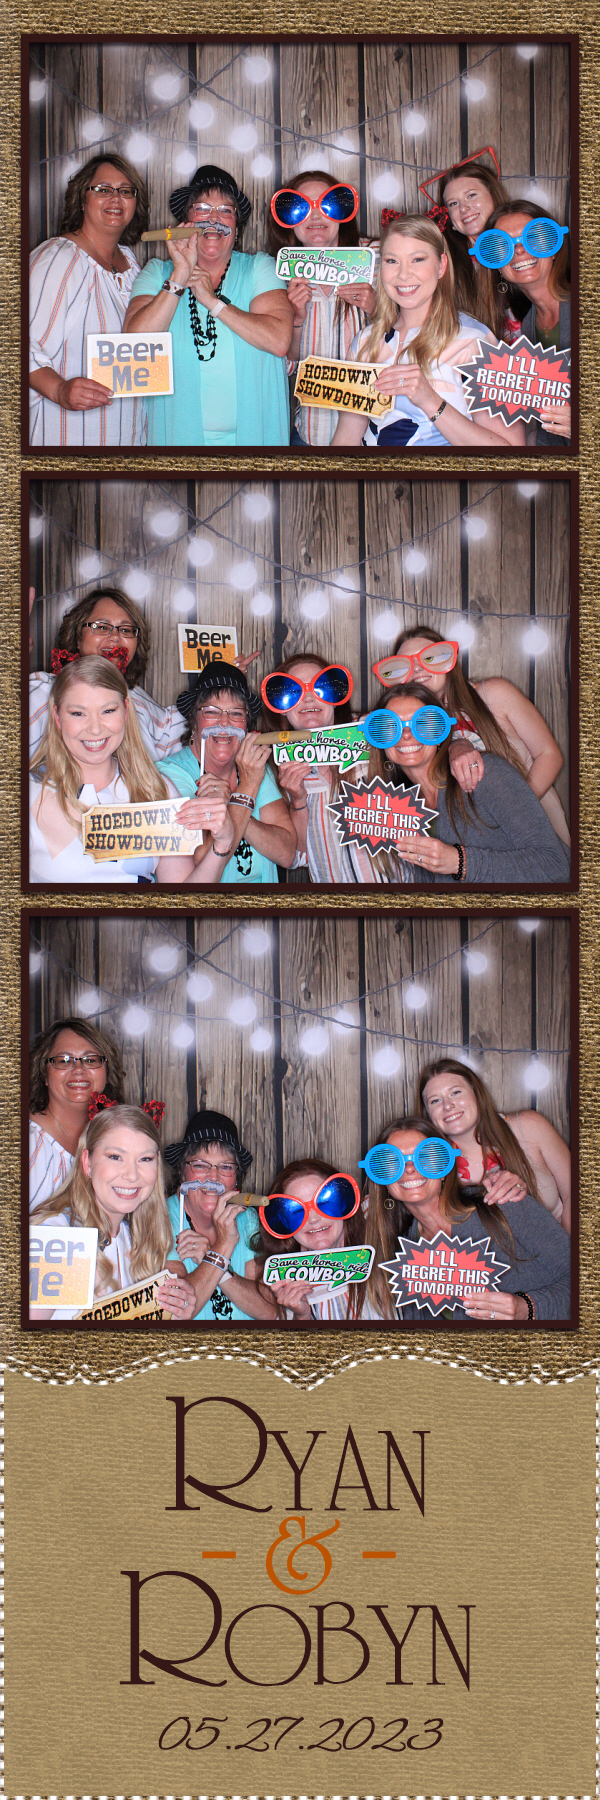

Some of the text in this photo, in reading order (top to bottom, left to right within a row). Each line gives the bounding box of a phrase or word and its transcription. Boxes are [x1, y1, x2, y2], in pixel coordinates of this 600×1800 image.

[278, 260, 360, 284] A COWBOY
[280, 249, 306, 260] Save
[318, 250, 348, 270] horse,
[350, 266, 372, 278] ride
[96, 340, 163, 366] Beer
[304, 364, 372, 386] HOEDOWN
[507, 355, 538, 376] I'LL
[112, 365, 150, 392] Me
[476, 368, 571, 398] REGRET THIS
[296, 379, 376, 413] SHOWDOWN
[184, 628, 231, 648] Beer
[196, 648, 222, 669] Me
[316, 732, 350, 748] horse,
[278, 744, 363, 763] A COWBOY
[367, 794, 392, 811] I'LL
[90, 808, 170, 832] HOEDOWN
[344, 806, 420, 830] REGRET THIS
[85, 832, 182, 852] SHOWDOWN
[29, 1238, 84, 1266] eer
[429, 1250, 458, 1267] I'LL
[267, 1266, 356, 1282] A COWBOY
[268, 1258, 300, 1268] Save
[312, 1254, 345, 1270] horse,
[348, 1262, 370, 1274] ride
[402, 1264, 490, 1285] REGRET THIS
